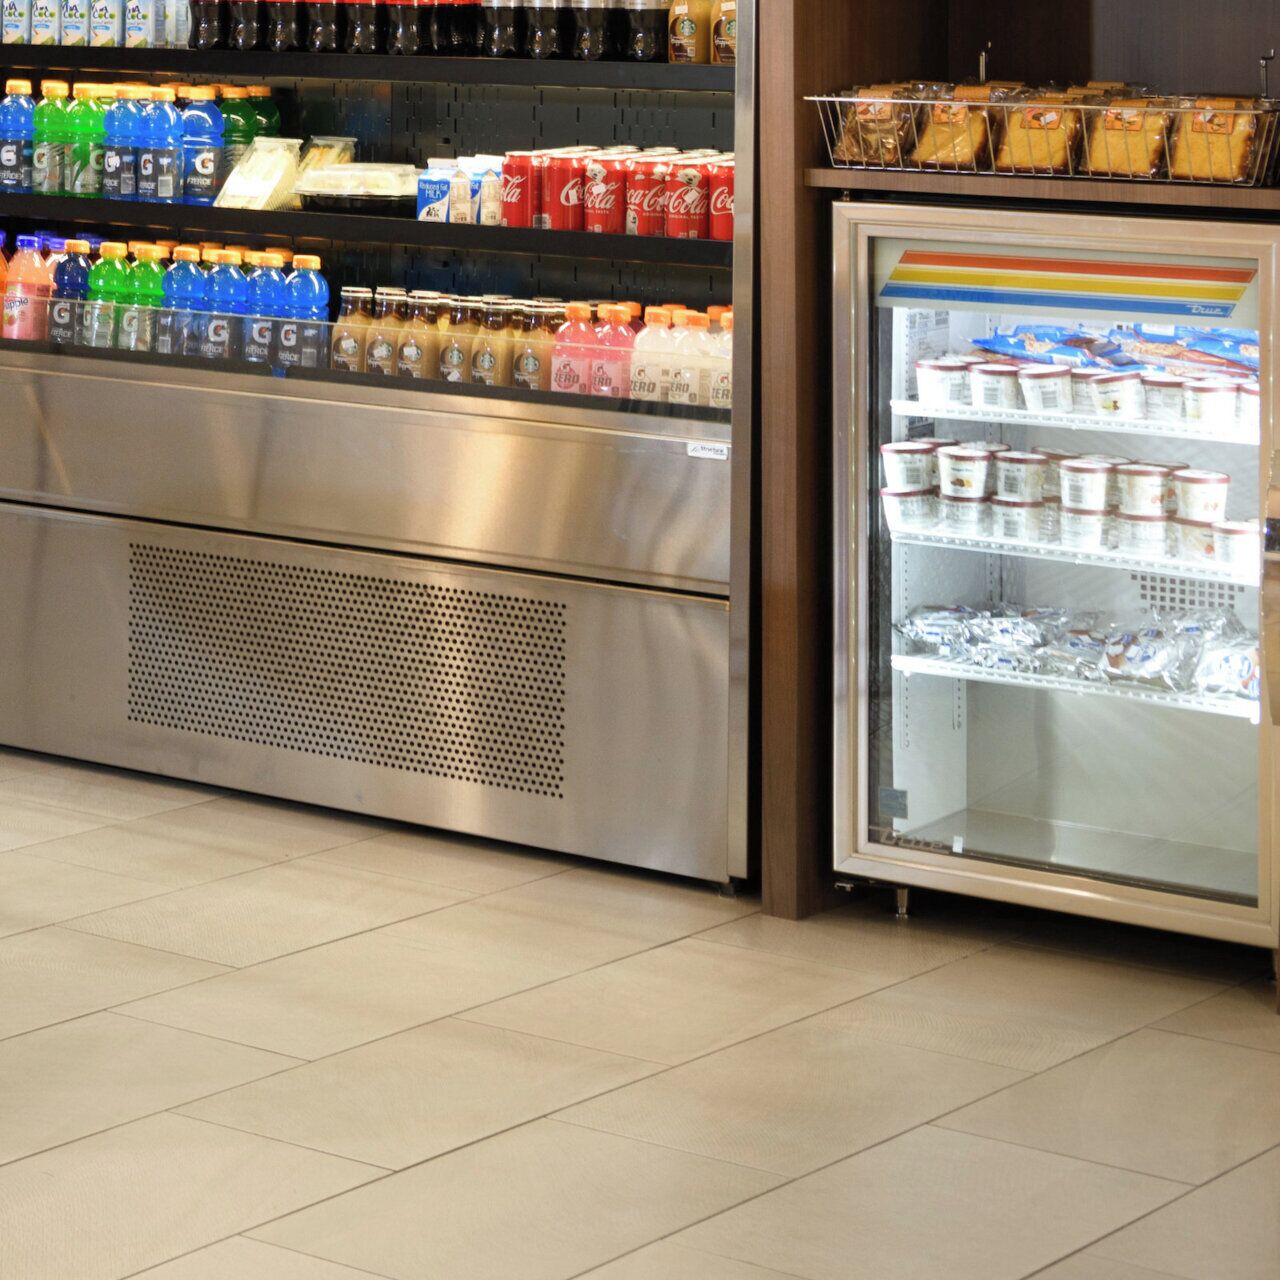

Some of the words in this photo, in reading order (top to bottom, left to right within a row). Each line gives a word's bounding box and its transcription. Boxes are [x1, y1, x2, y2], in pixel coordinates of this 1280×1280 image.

[195, 152, 215, 175] G
[53, 302, 70, 324] G
[207, 321, 228, 343] G
[252, 322, 272, 344] G
[280, 324, 297, 347] G
[553, 372, 580, 384] ZERO
